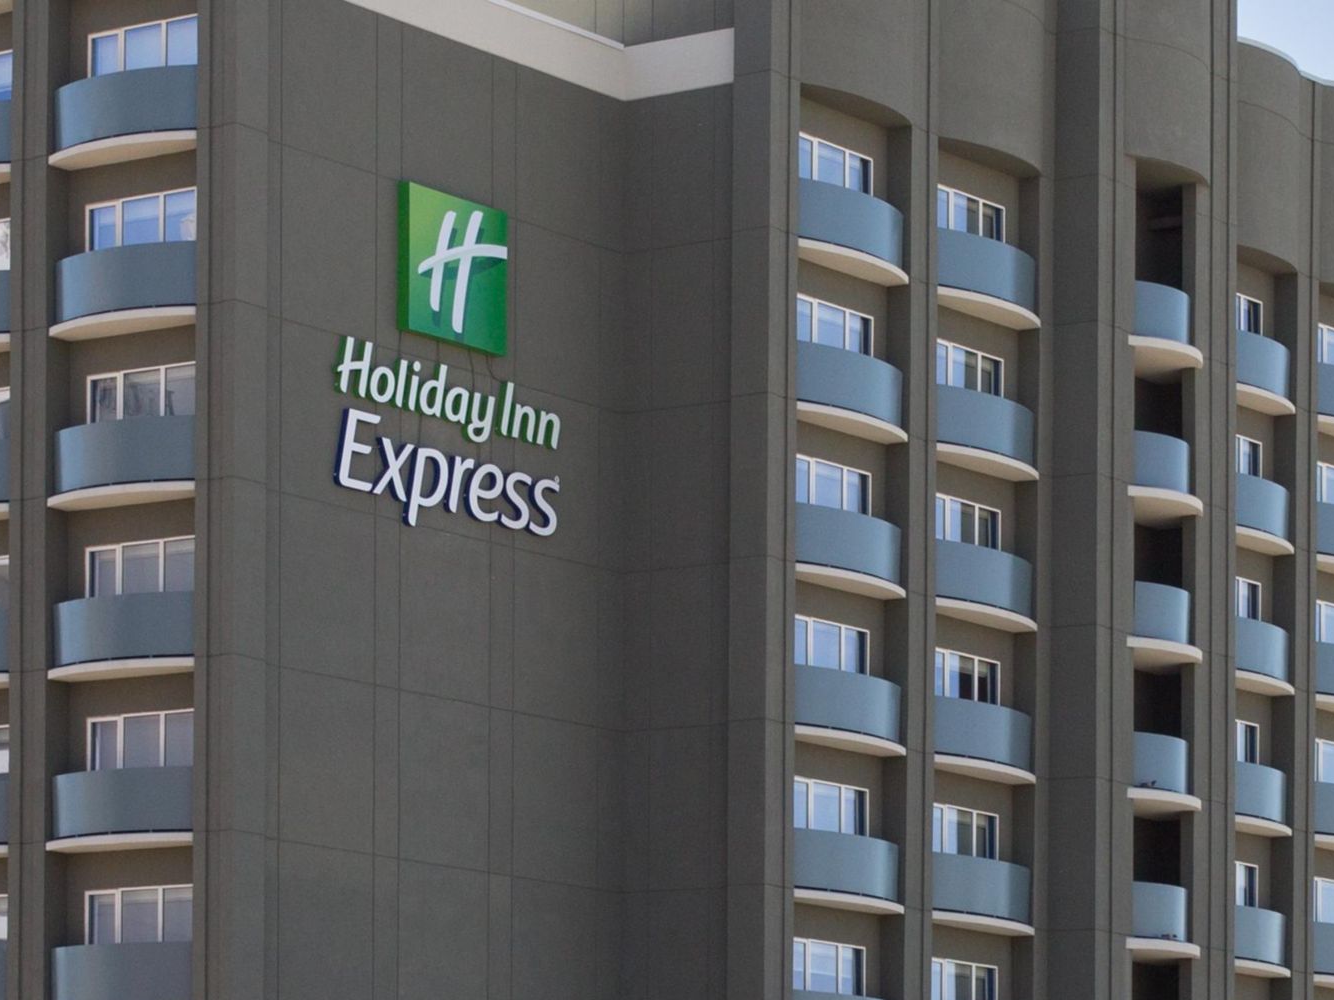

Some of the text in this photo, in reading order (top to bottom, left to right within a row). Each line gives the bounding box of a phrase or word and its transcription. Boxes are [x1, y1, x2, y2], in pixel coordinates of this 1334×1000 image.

[335, 336, 561, 450] Holiday Inn
[336, 408, 561, 537] Express
